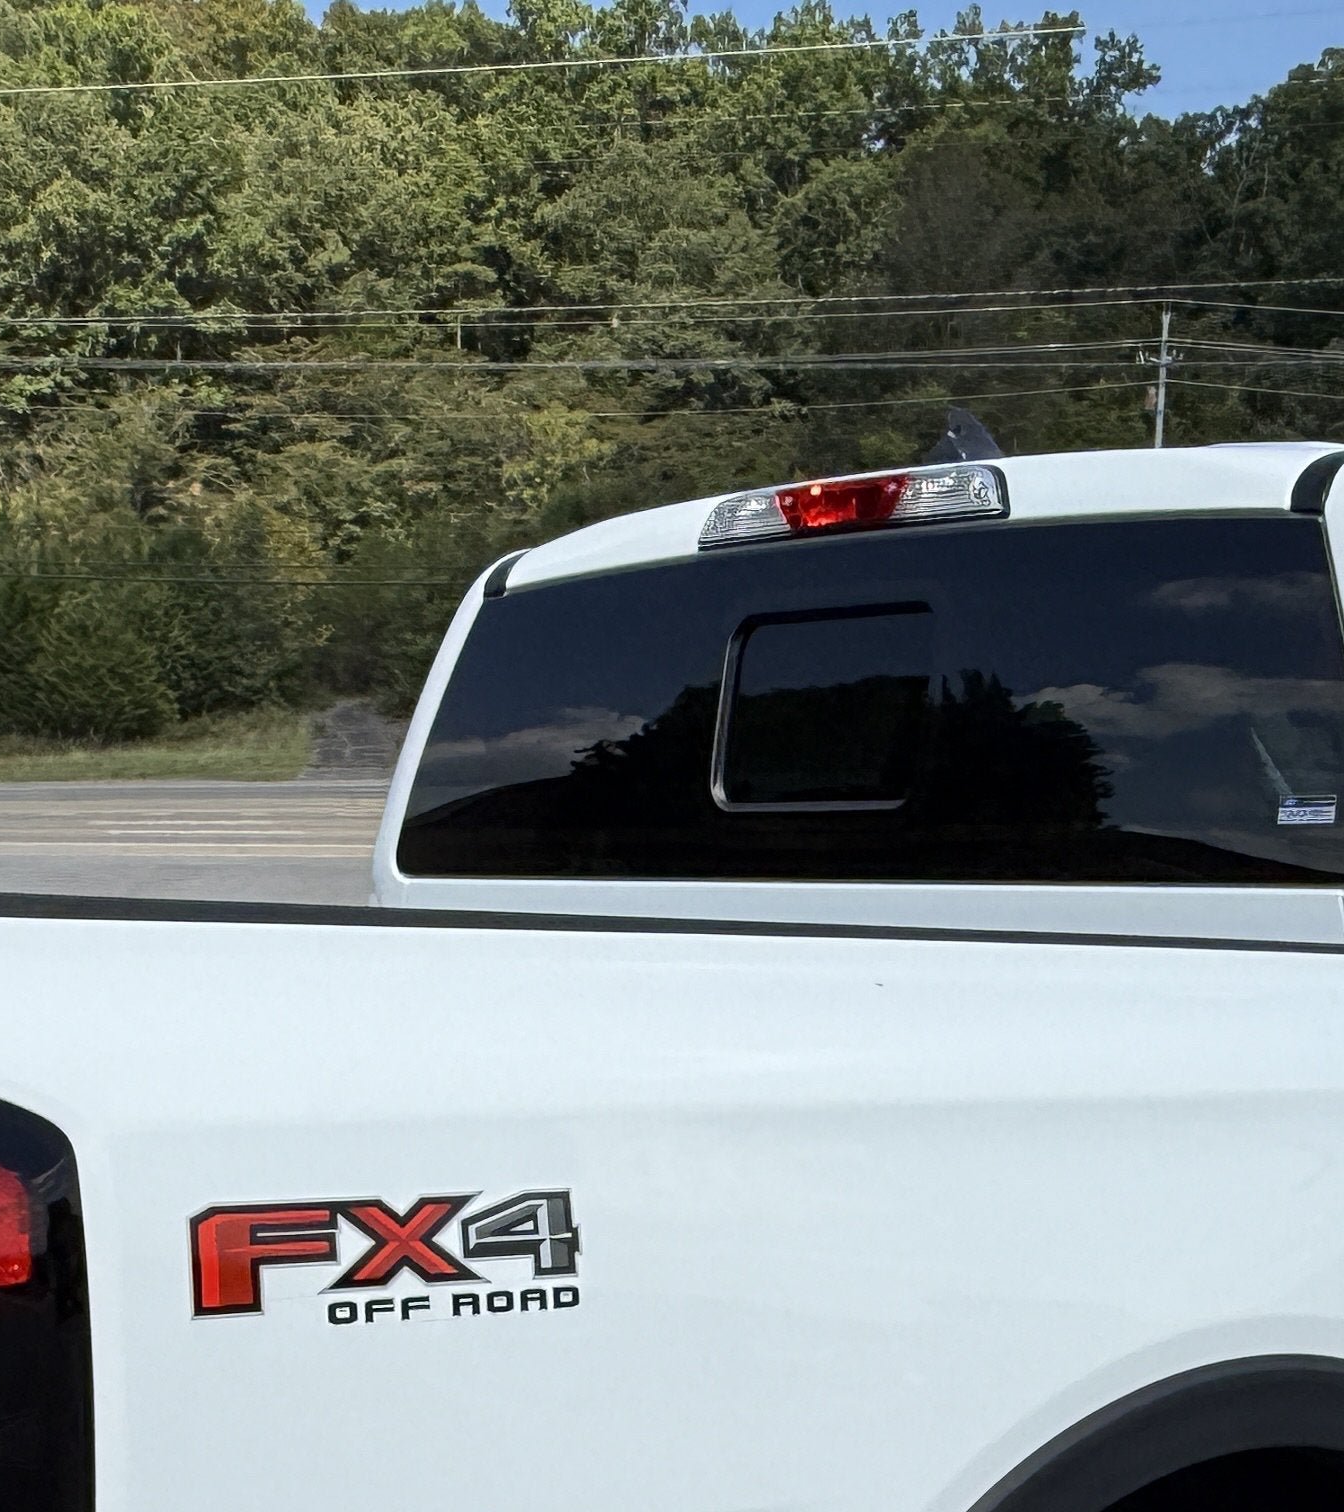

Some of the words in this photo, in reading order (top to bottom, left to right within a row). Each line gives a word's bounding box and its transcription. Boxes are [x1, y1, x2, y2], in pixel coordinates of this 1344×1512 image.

[187, 1188, 581, 1319] FX4
[327, 1295, 431, 1325] OFF
[451, 1286, 580, 1318] ROAD
